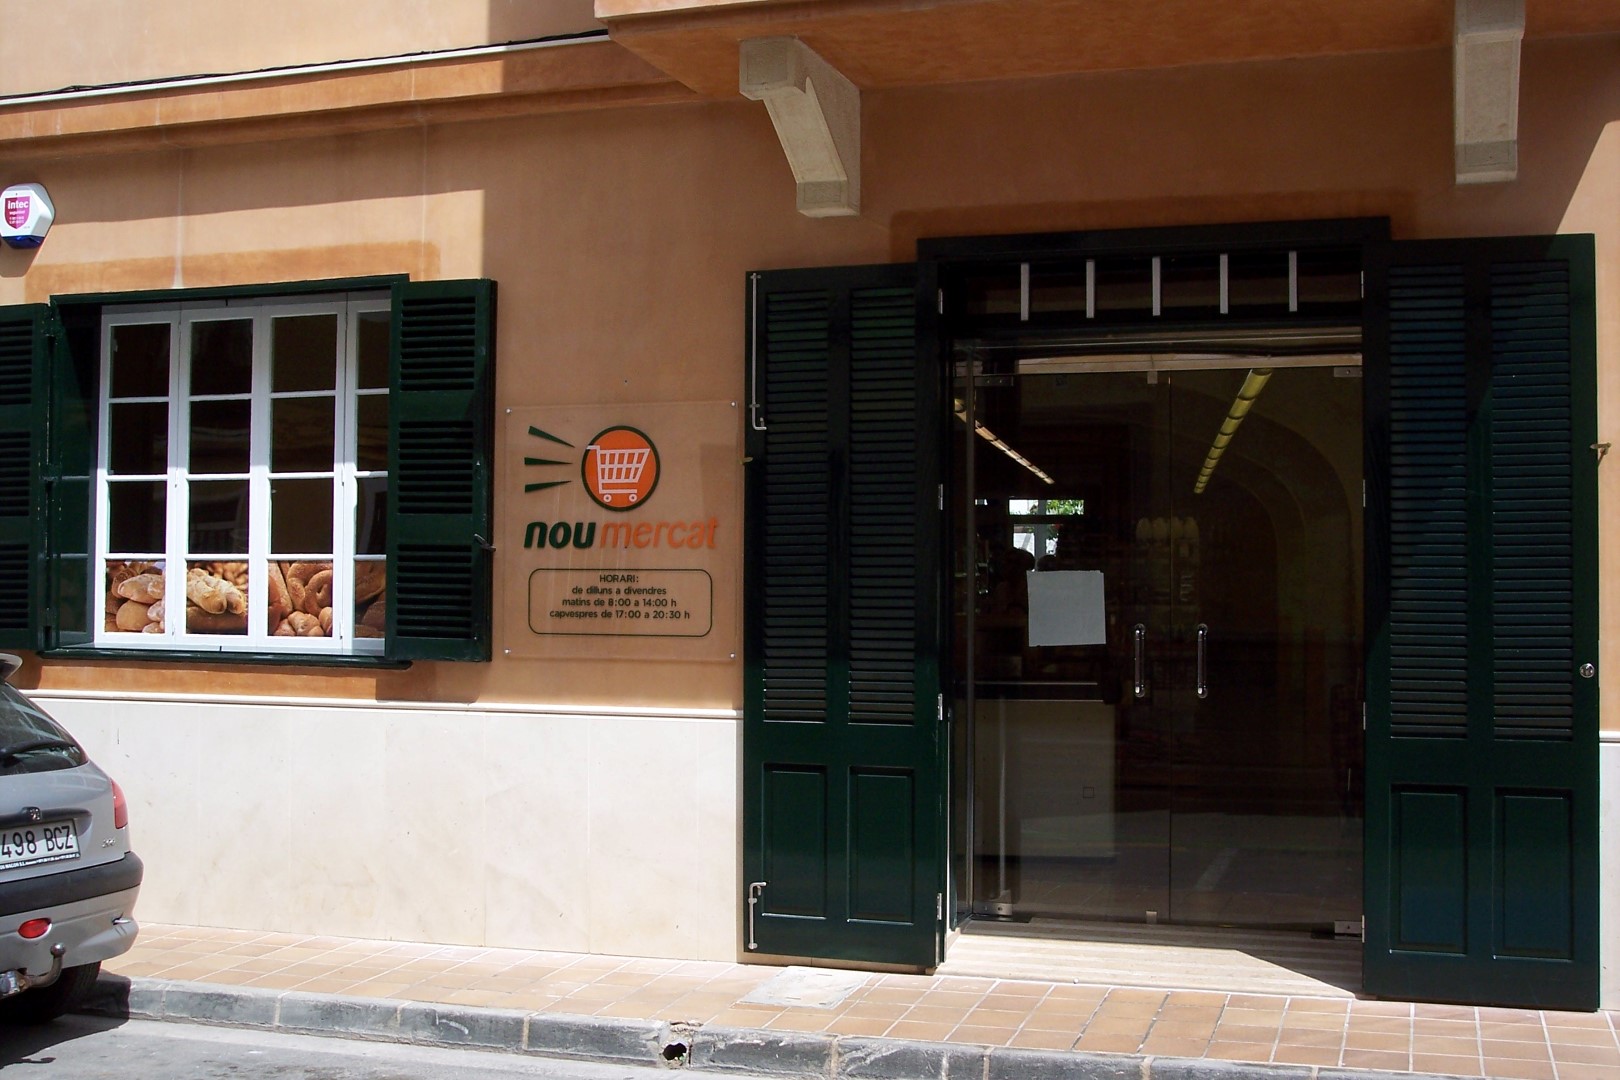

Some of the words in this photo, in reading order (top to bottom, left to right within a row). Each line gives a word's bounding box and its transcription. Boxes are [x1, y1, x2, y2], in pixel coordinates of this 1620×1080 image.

[523, 521, 597, 550] nou
[600, 516, 719, 550] mercat
[599, 574, 639, 583] HORARI:
[571, 586, 583, 595] de
[586, 586, 613, 595] dilluns
[624, 586, 667, 595] divendres
[562, 598, 591, 607] matins
[593, 598, 605, 607] de
[608, 598, 631, 607] 8:00
[643, 598, 668, 607] 14:00
[671, 598, 677, 607] h
[549, 609, 598, 619] capvespres
[601, 609, 613, 619] de
[615, 610, 641, 619] 17:00
[652, 610, 681, 619] 20:30
[684, 610, 690, 619] h
[44, 825, 73, 851] BCZ
